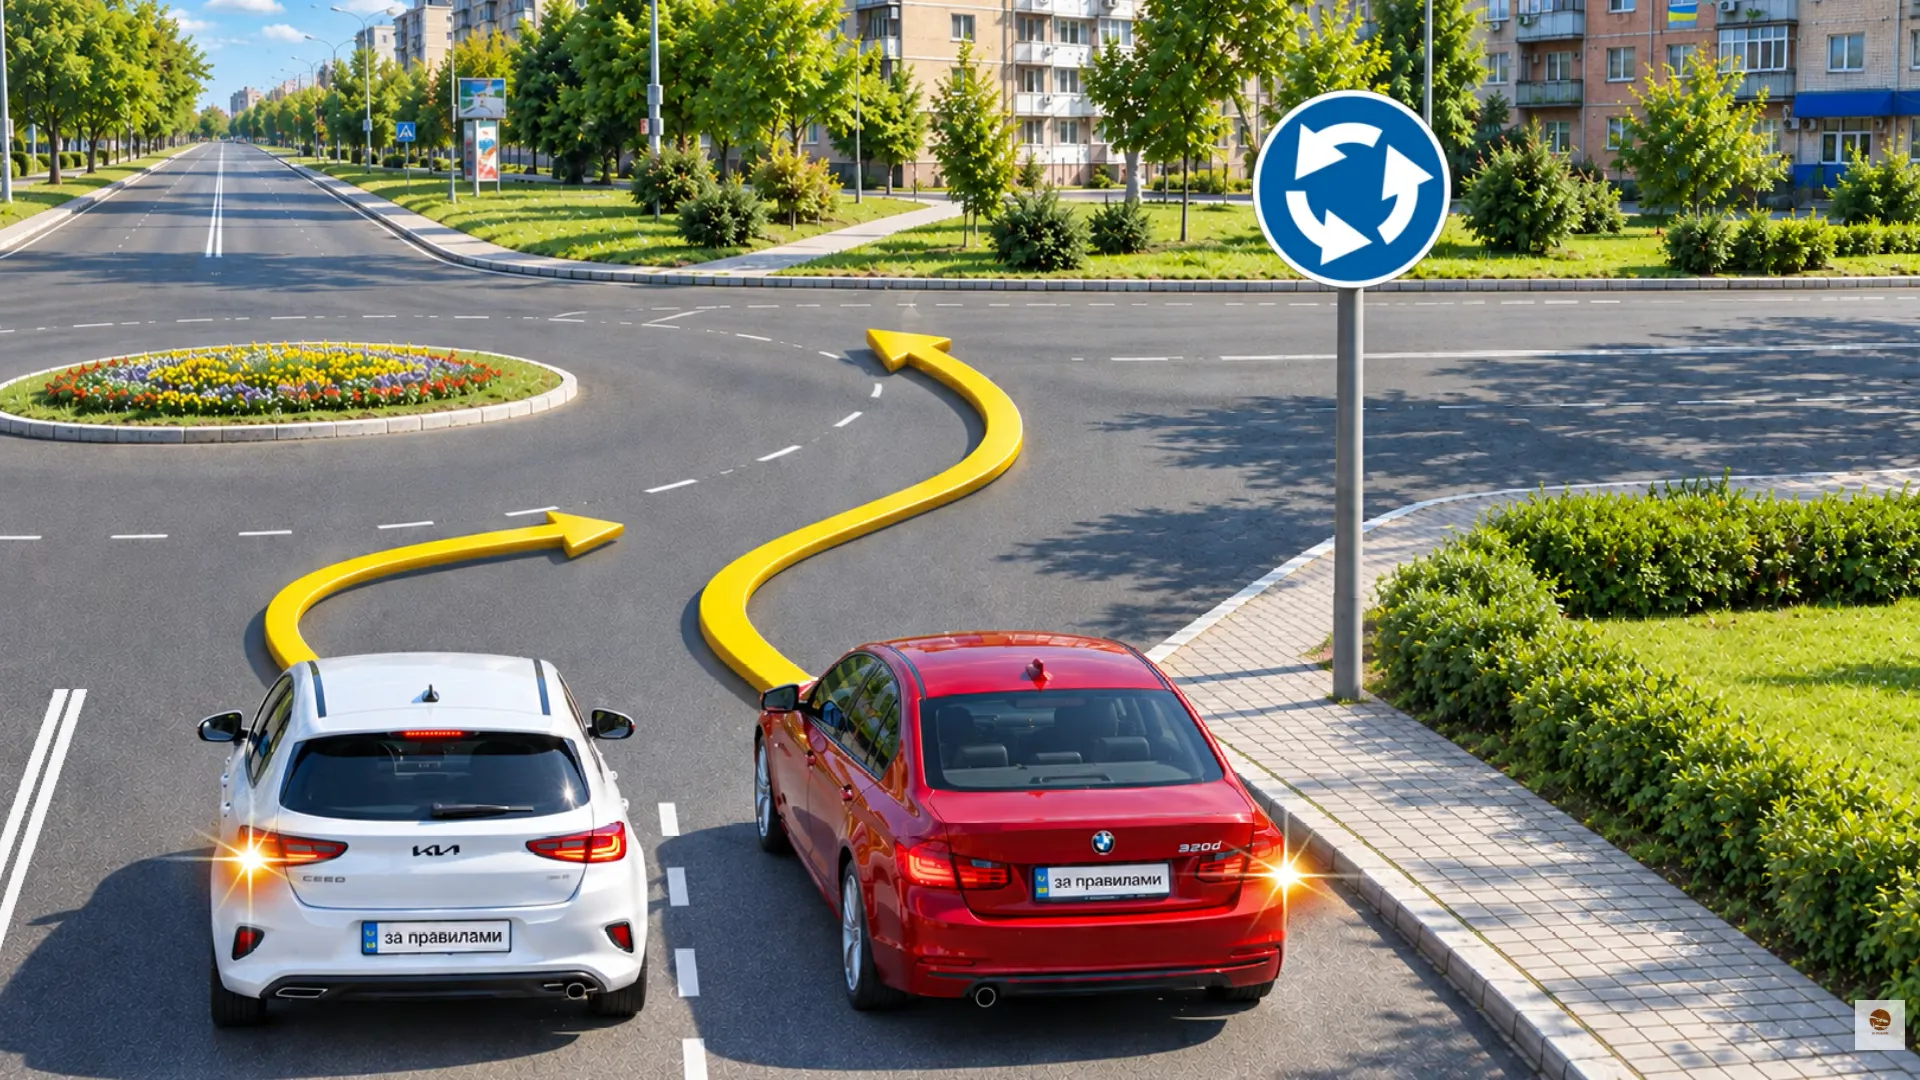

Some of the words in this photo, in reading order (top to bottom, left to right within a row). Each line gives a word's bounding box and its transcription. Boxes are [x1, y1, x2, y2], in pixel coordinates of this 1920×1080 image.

[1178, 840, 1222, 853] 320d
[1054, 877, 1072, 889] за
[1075, 875, 1162, 890] правилами
[384, 932, 403, 945] за
[408, 931, 503, 947] правилами
